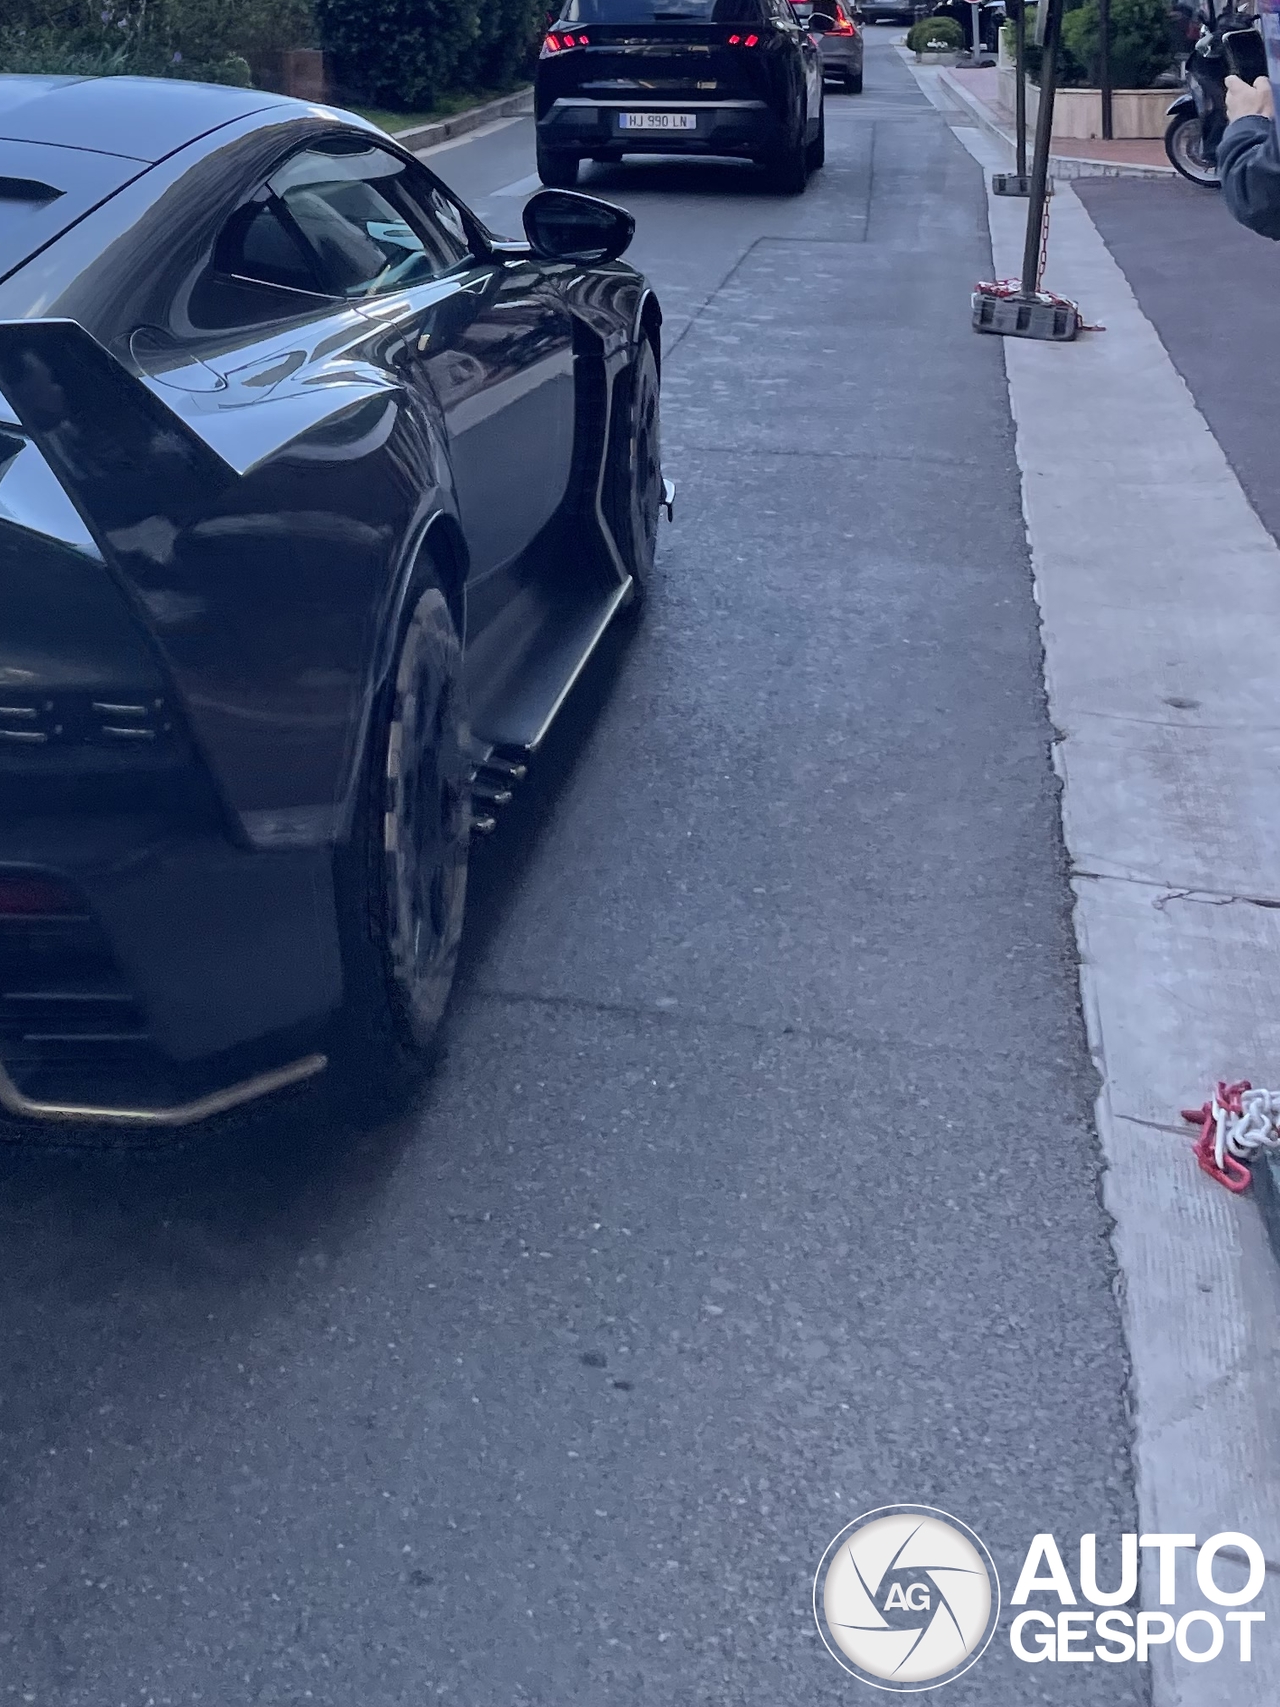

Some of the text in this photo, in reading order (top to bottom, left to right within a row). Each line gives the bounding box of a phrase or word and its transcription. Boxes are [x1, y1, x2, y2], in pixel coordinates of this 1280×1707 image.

[629, 115, 687, 127] HJ 990 LN
